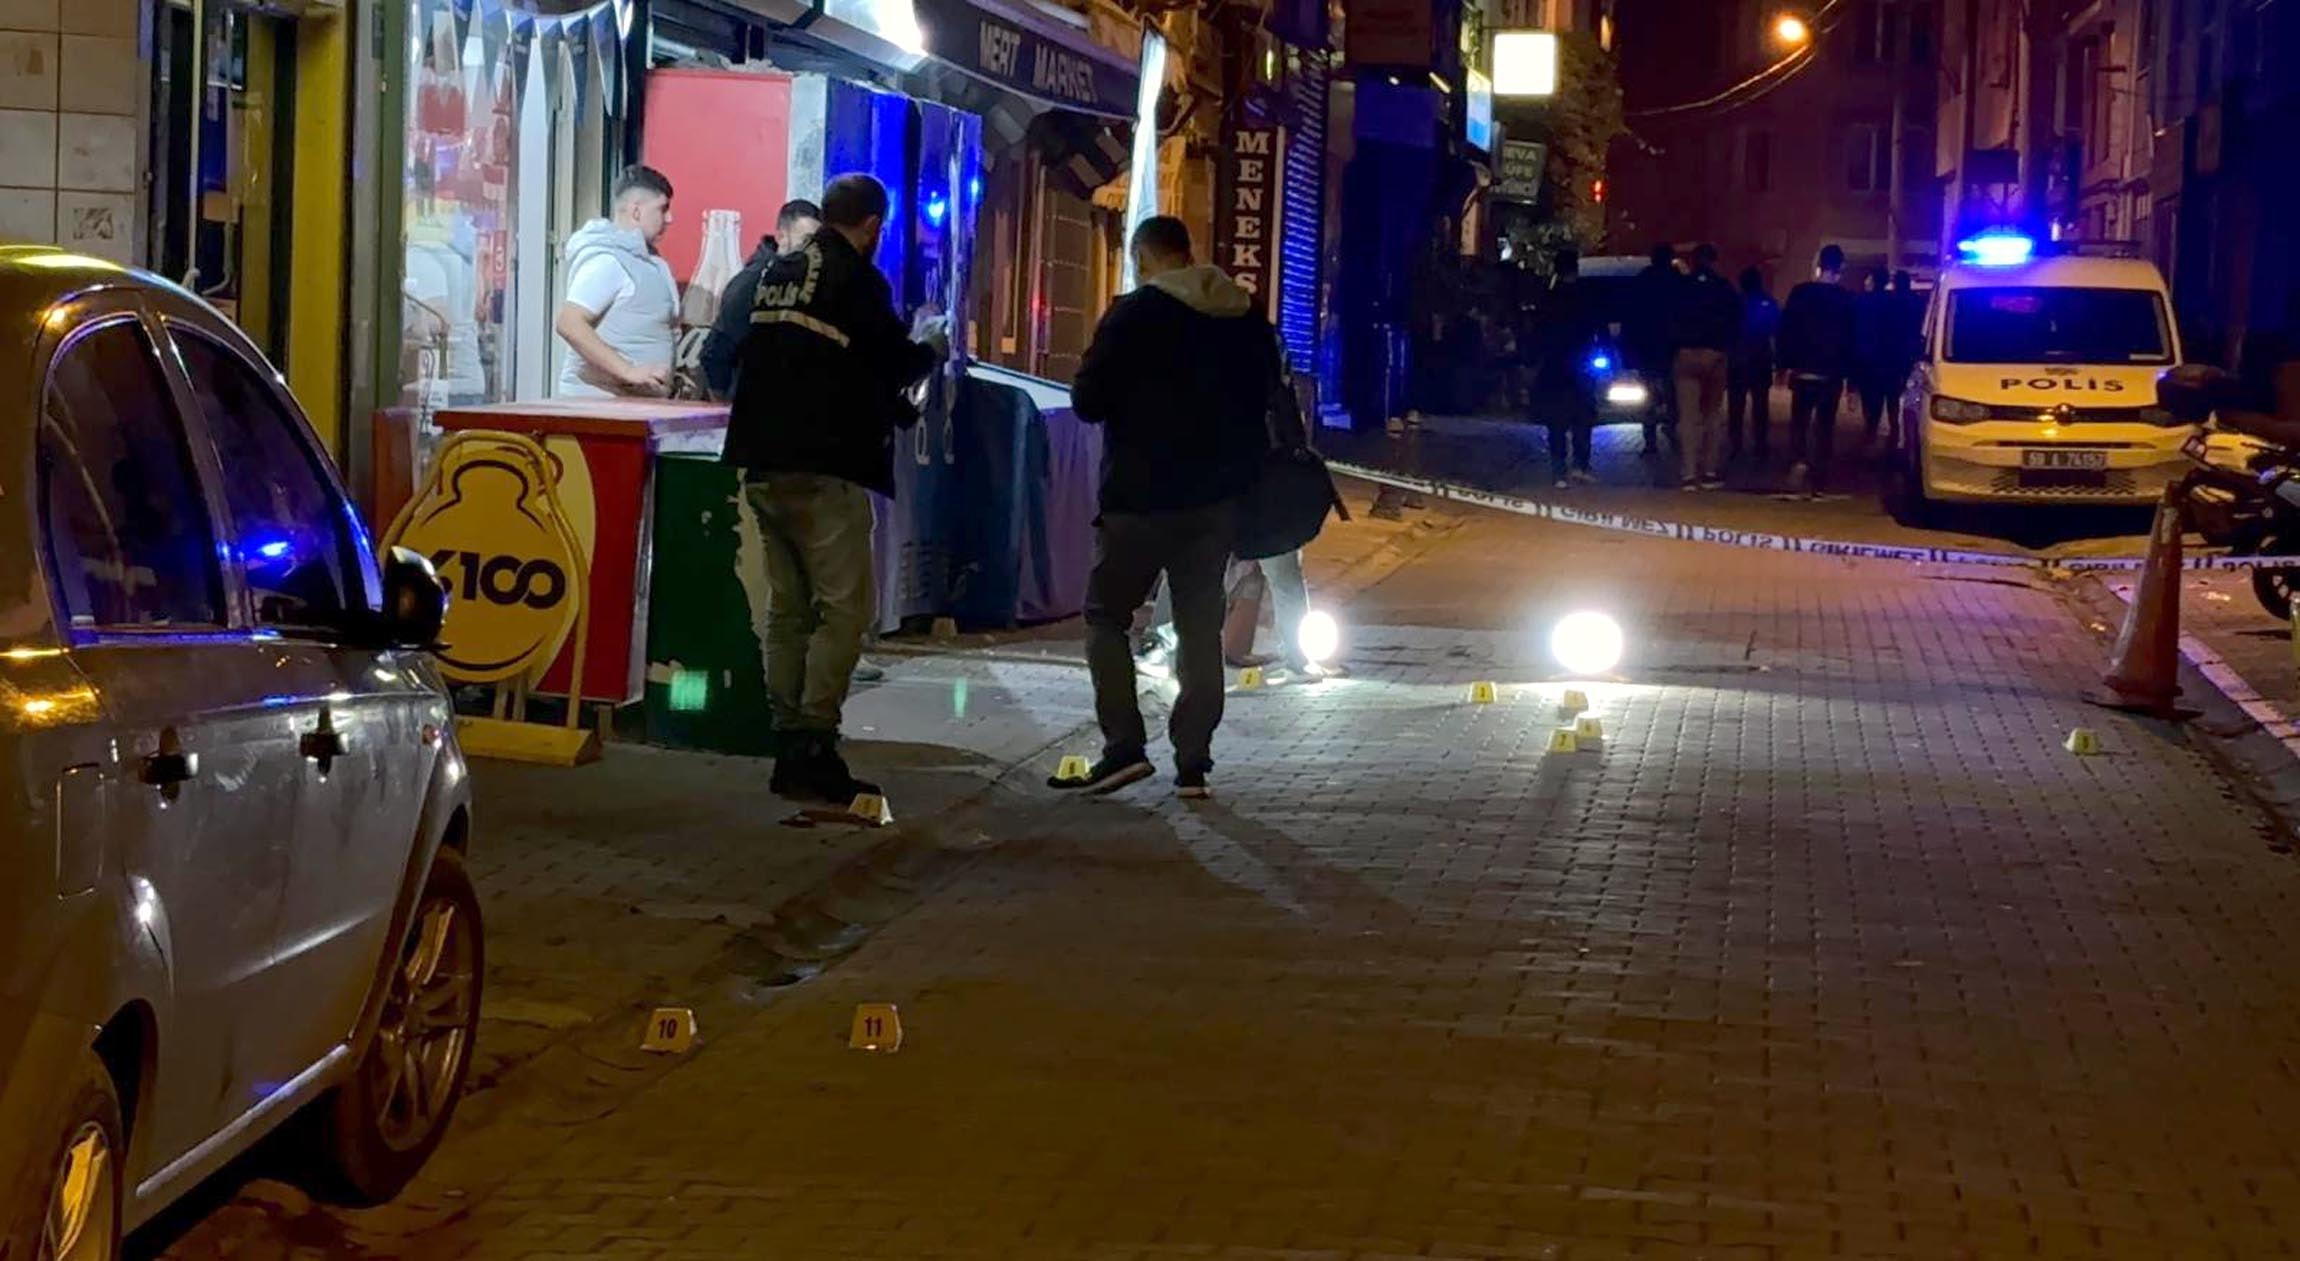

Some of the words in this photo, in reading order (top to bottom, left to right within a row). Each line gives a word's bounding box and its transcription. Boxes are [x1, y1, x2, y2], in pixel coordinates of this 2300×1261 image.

[979, 20, 1021, 77] MERT
[1031, 42, 1098, 103] MARKET
[658, 1019, 677, 1038] 10
[864, 1017, 881, 1036] 11
